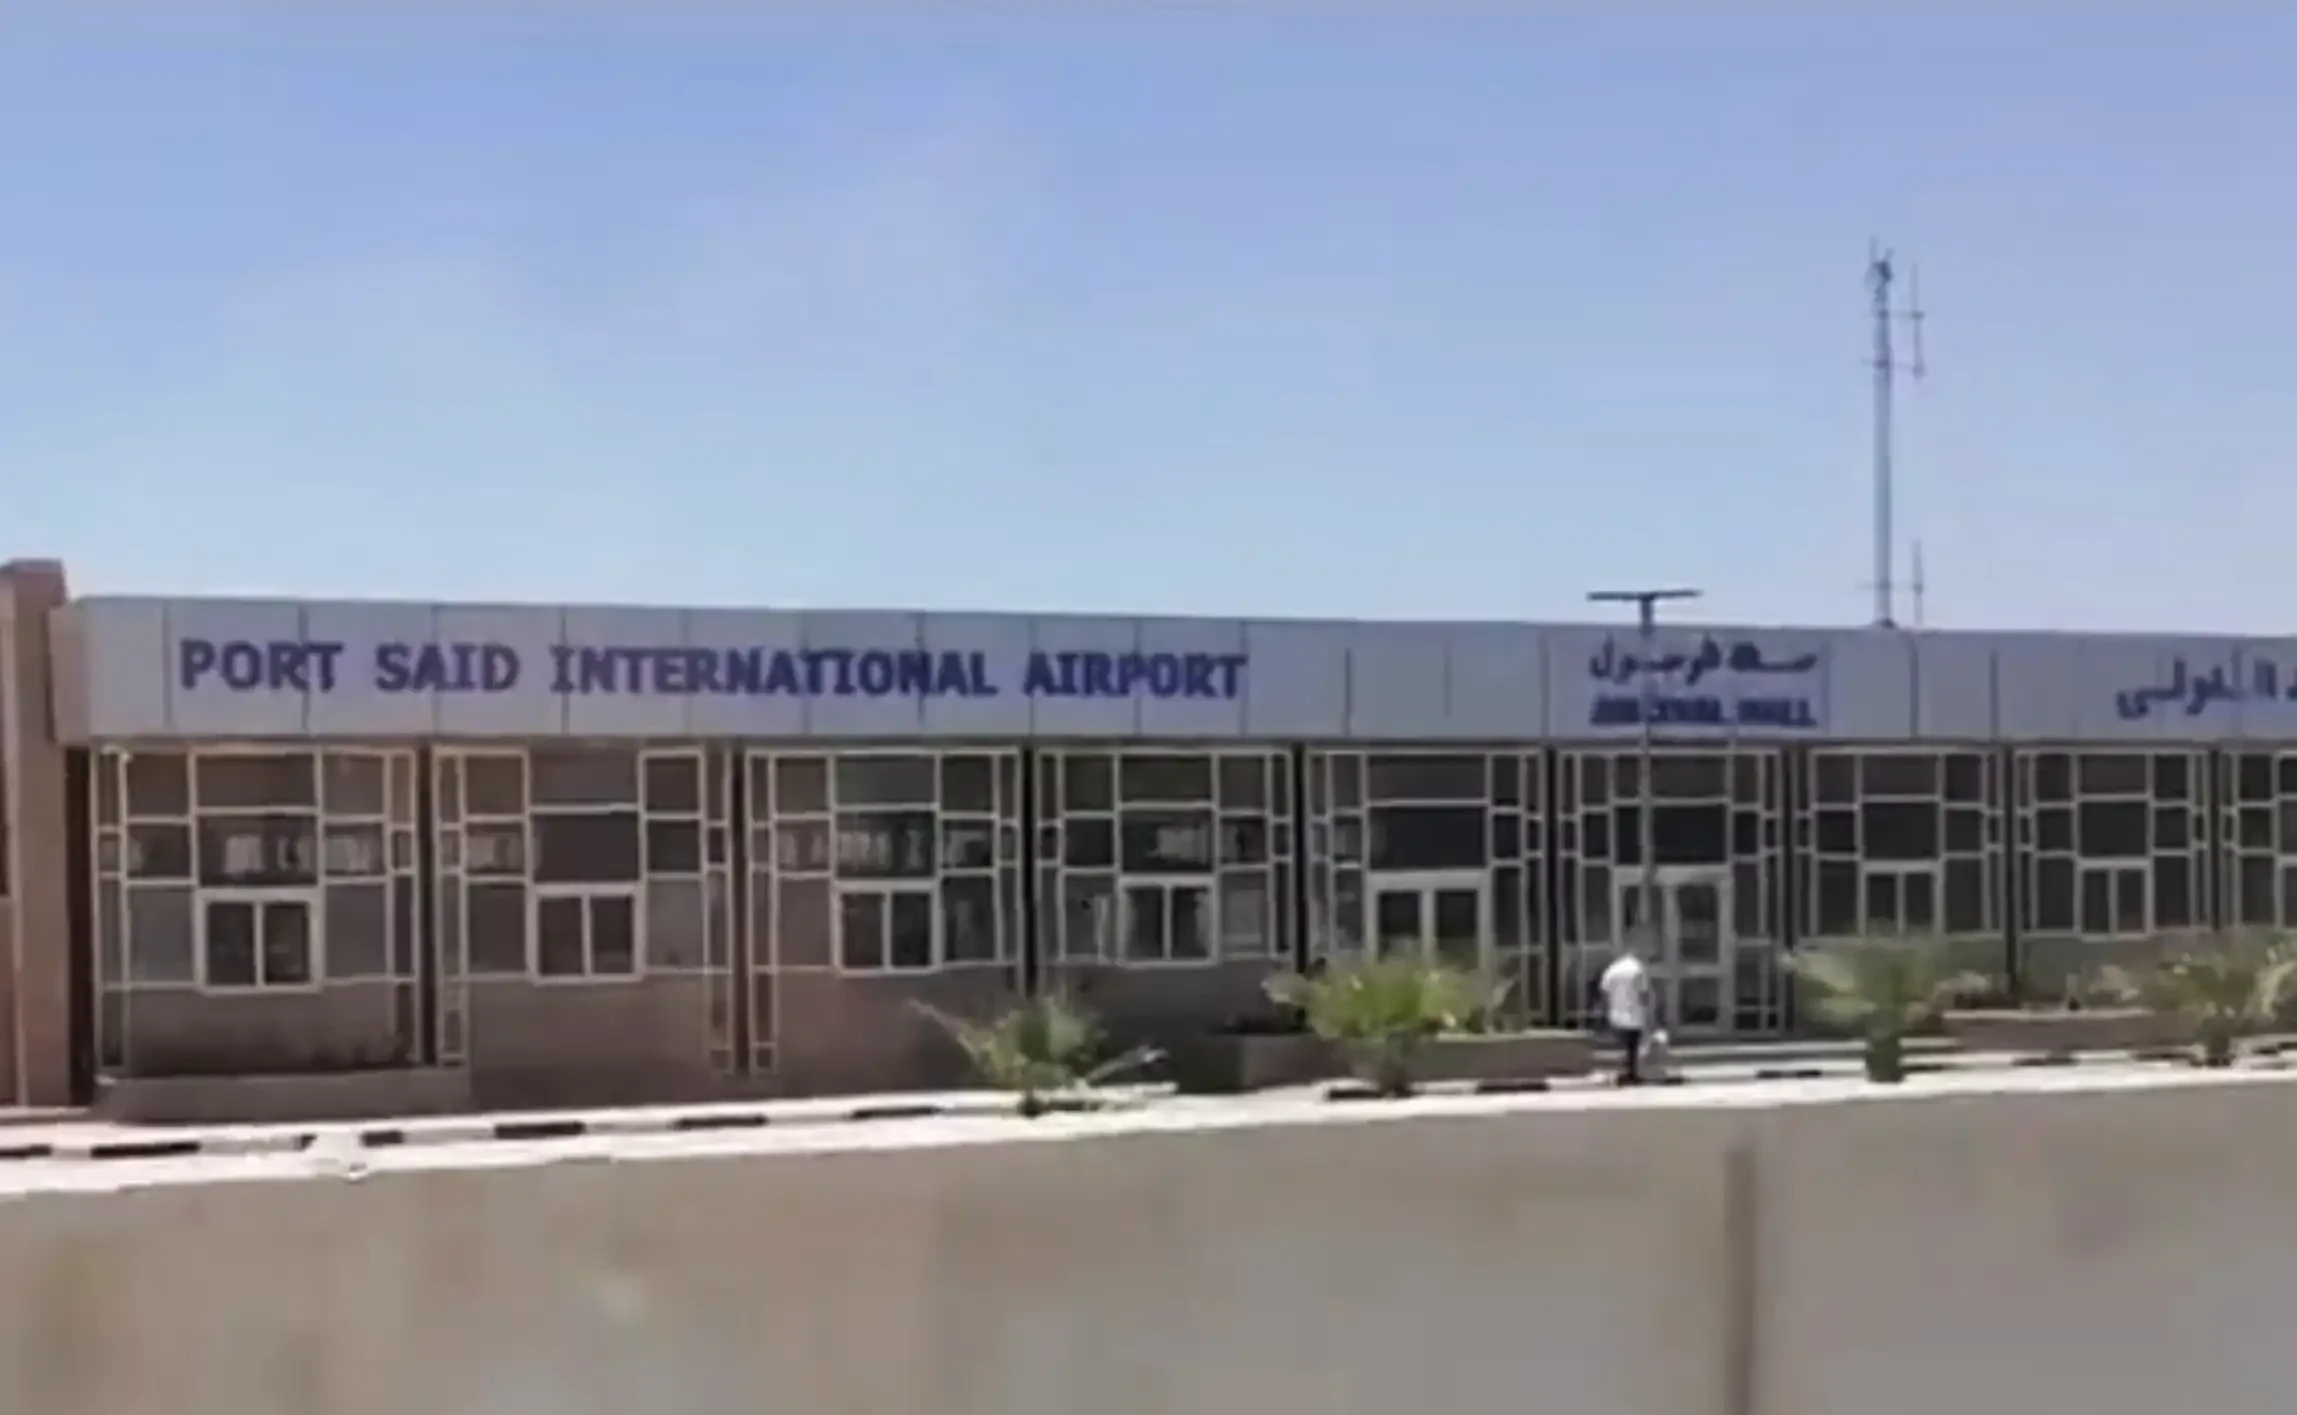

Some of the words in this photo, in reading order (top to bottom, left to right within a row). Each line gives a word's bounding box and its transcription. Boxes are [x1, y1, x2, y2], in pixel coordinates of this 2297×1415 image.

[179, 638, 344, 692] PORT
[374, 642, 520, 692] SAID
[549, 643, 998, 695] INTERNATIONAL
[1023, 652, 1248, 697] AIRPORT
